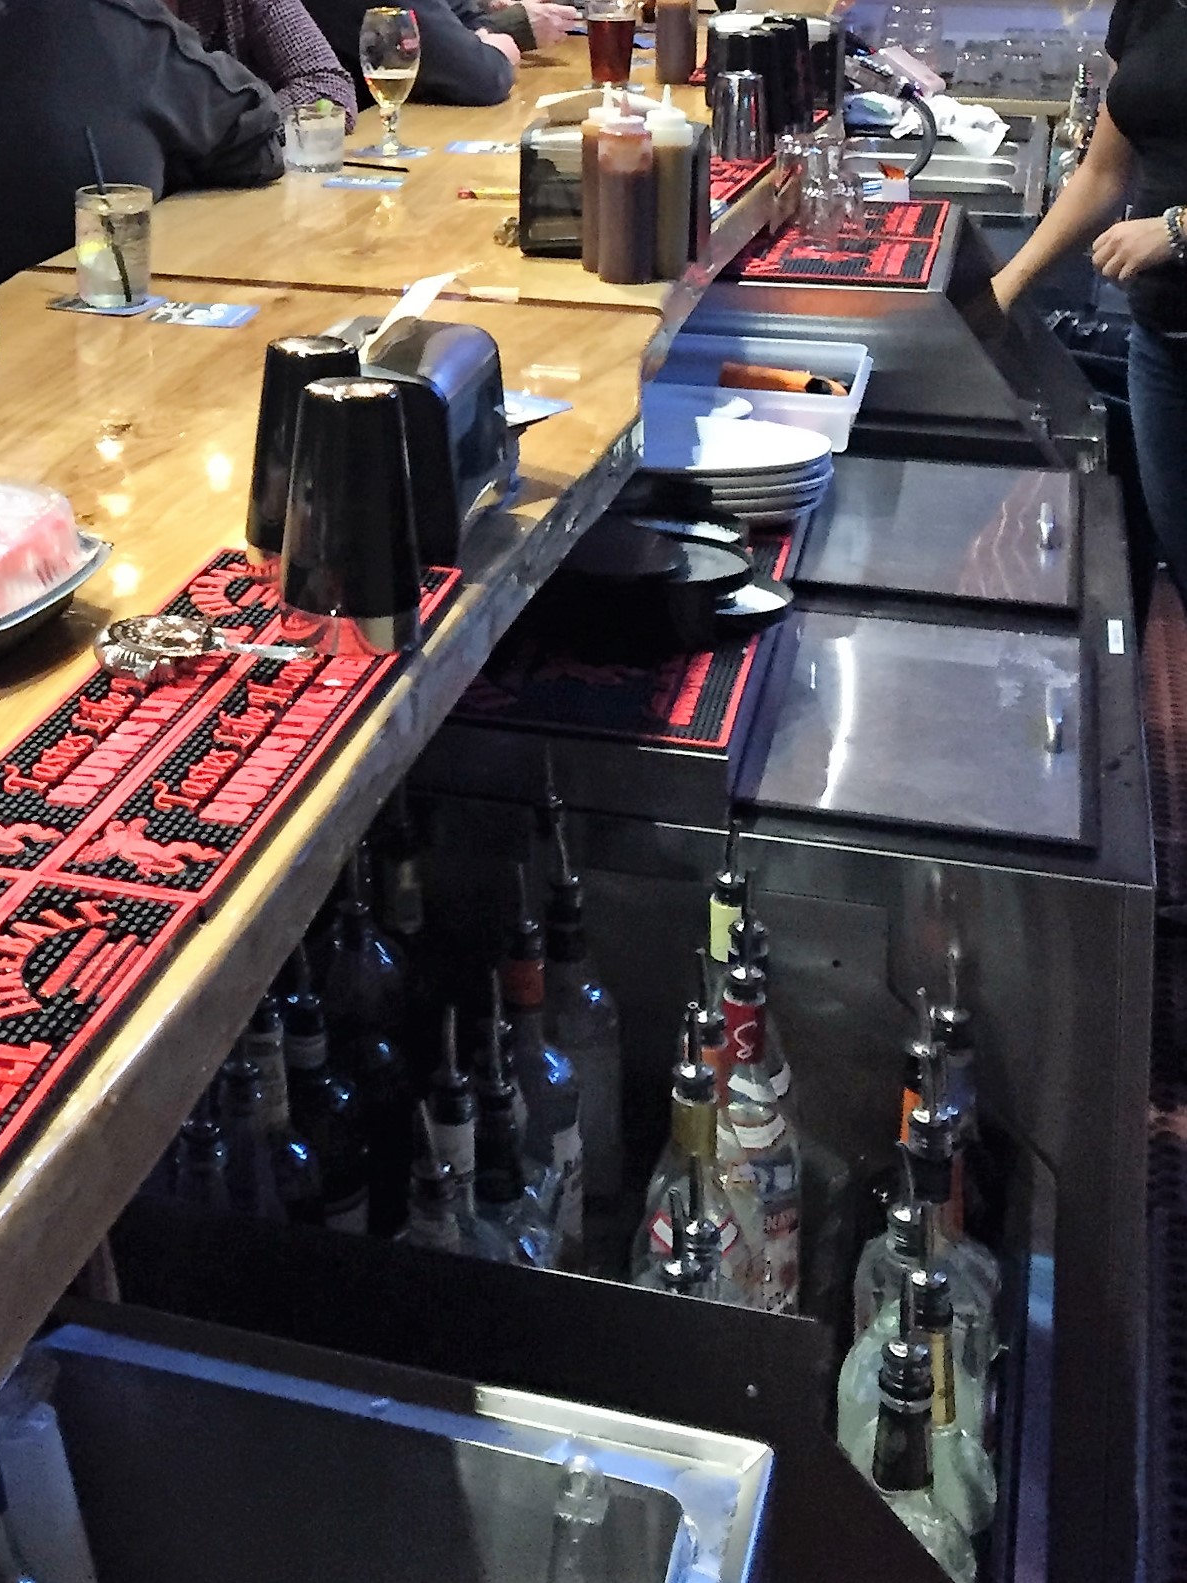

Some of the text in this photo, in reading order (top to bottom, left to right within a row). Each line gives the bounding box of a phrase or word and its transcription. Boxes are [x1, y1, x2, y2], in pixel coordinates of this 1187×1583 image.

[3, 730, 94, 795] Tastes
[46, 720, 161, 809] BURNS
[152, 748, 239, 812] Tastes
[199, 735, 308, 825] BURNS
